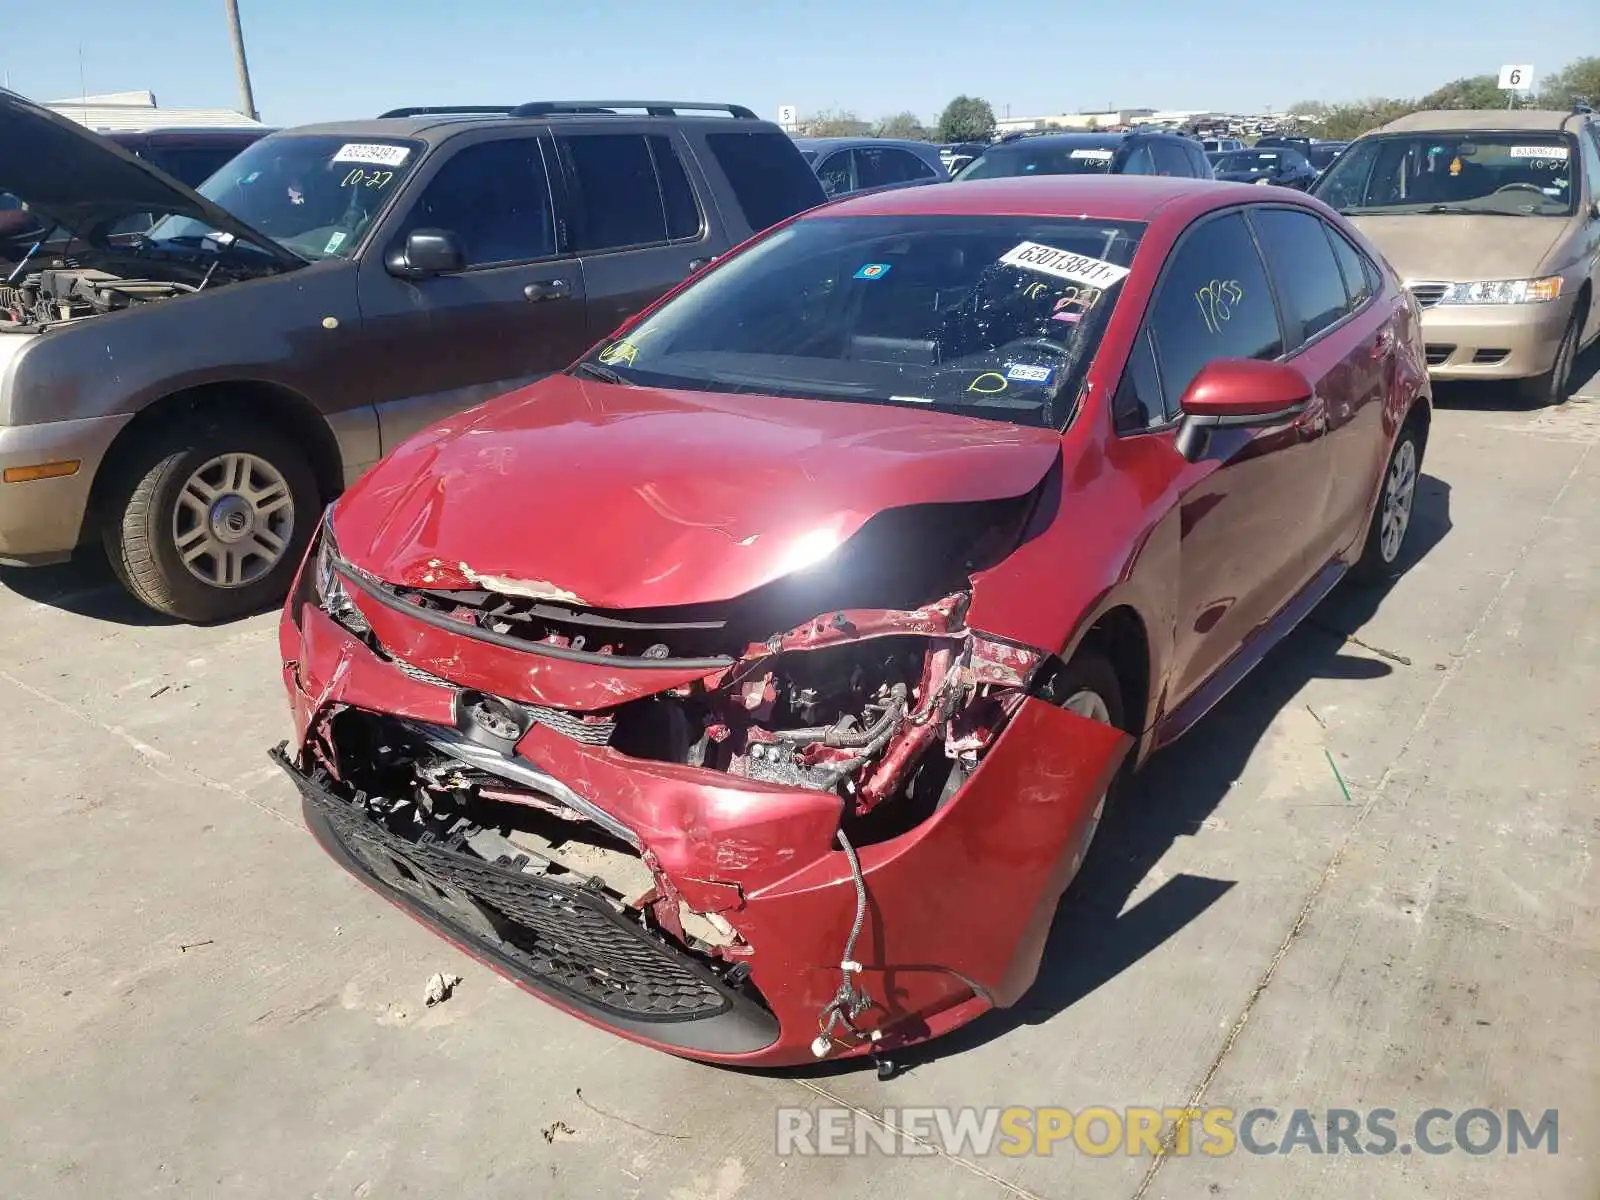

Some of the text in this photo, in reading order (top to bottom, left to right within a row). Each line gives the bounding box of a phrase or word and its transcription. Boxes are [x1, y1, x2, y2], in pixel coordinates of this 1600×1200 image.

[1510, 69, 1521, 85] 6
[783, 109, 790, 120] 5
[341, 169, 392, 189] 10-27
